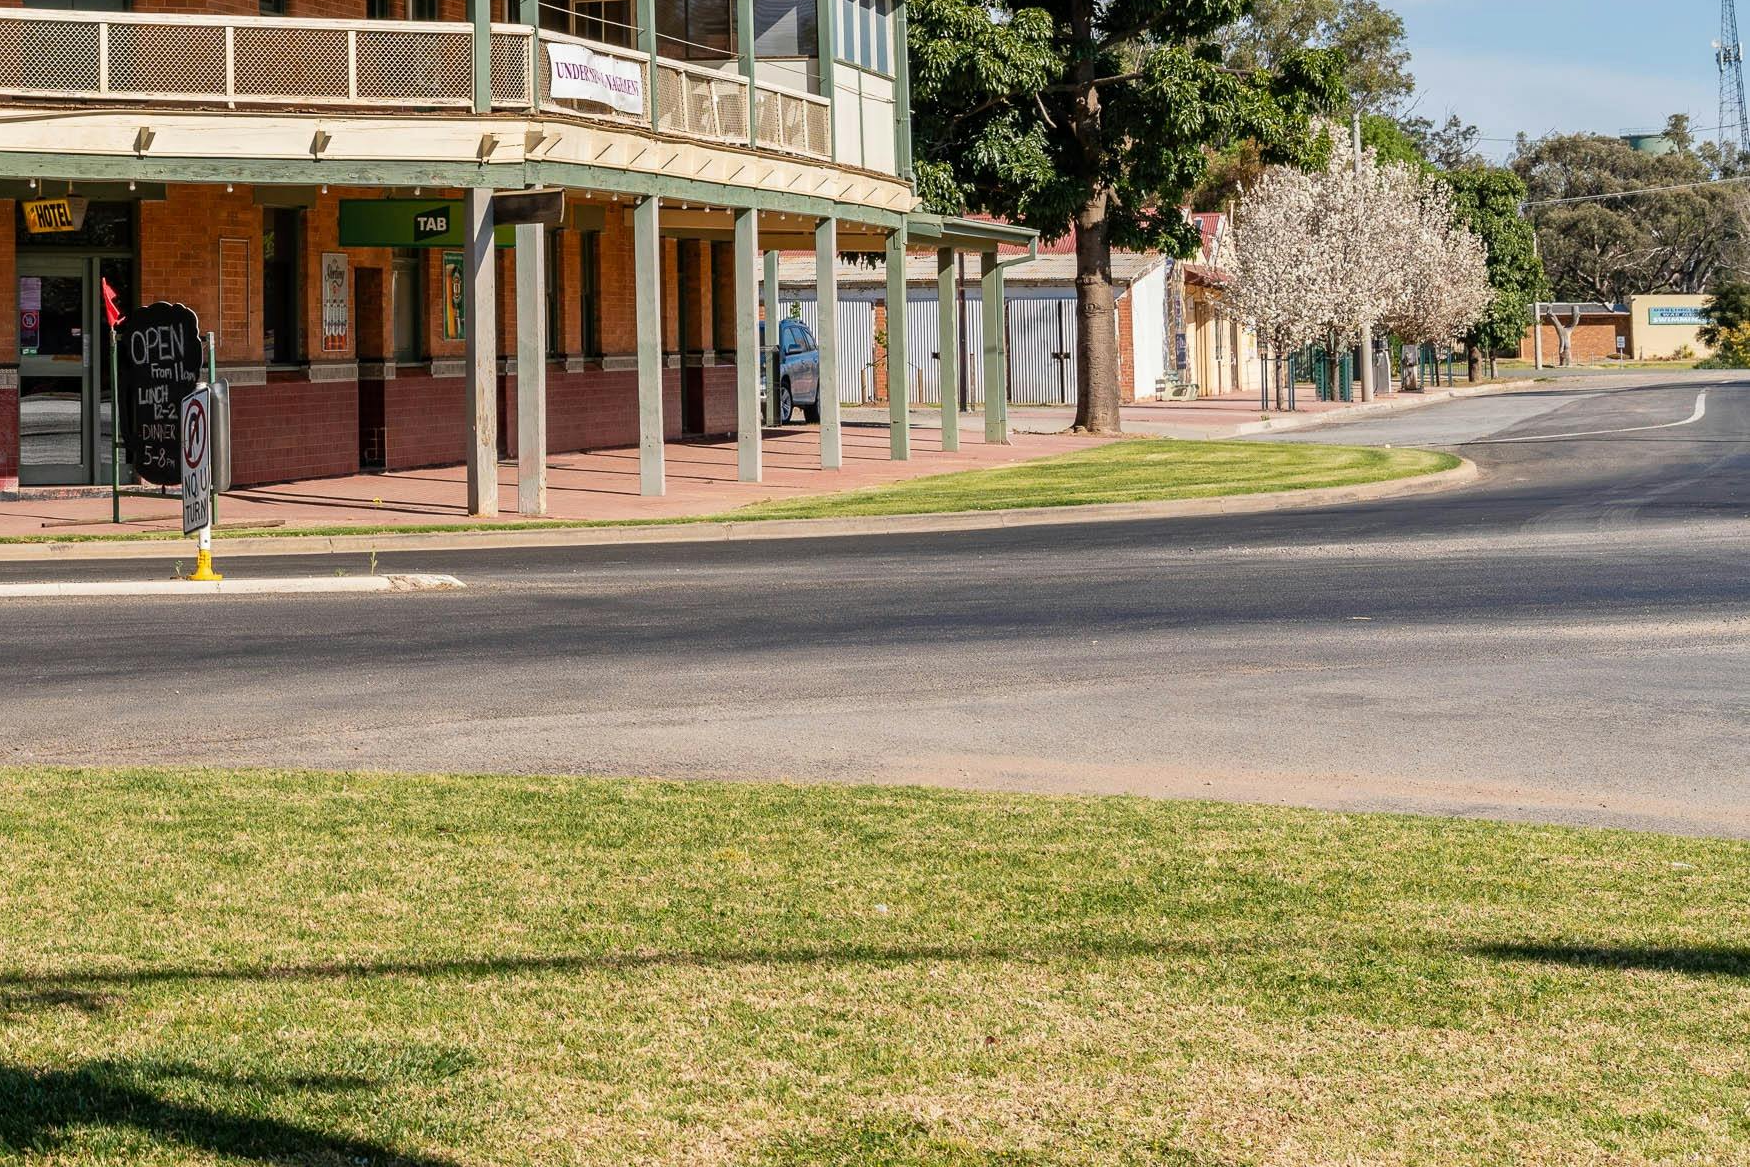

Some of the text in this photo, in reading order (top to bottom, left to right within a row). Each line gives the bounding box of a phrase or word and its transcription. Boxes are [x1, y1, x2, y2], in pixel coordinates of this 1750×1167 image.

[555, 61, 590, 83] UNDER
[34, 202, 73, 228] HOTEL
[417, 216, 447, 231] TAB
[130, 323, 185, 365] OPEN
[150, 363, 173, 380] From
[138, 384, 169, 406] LUNCH
[142, 423, 176, 443] DINNER
[184, 468, 207, 500] NO U
[185, 498, 207, 525] TURN
